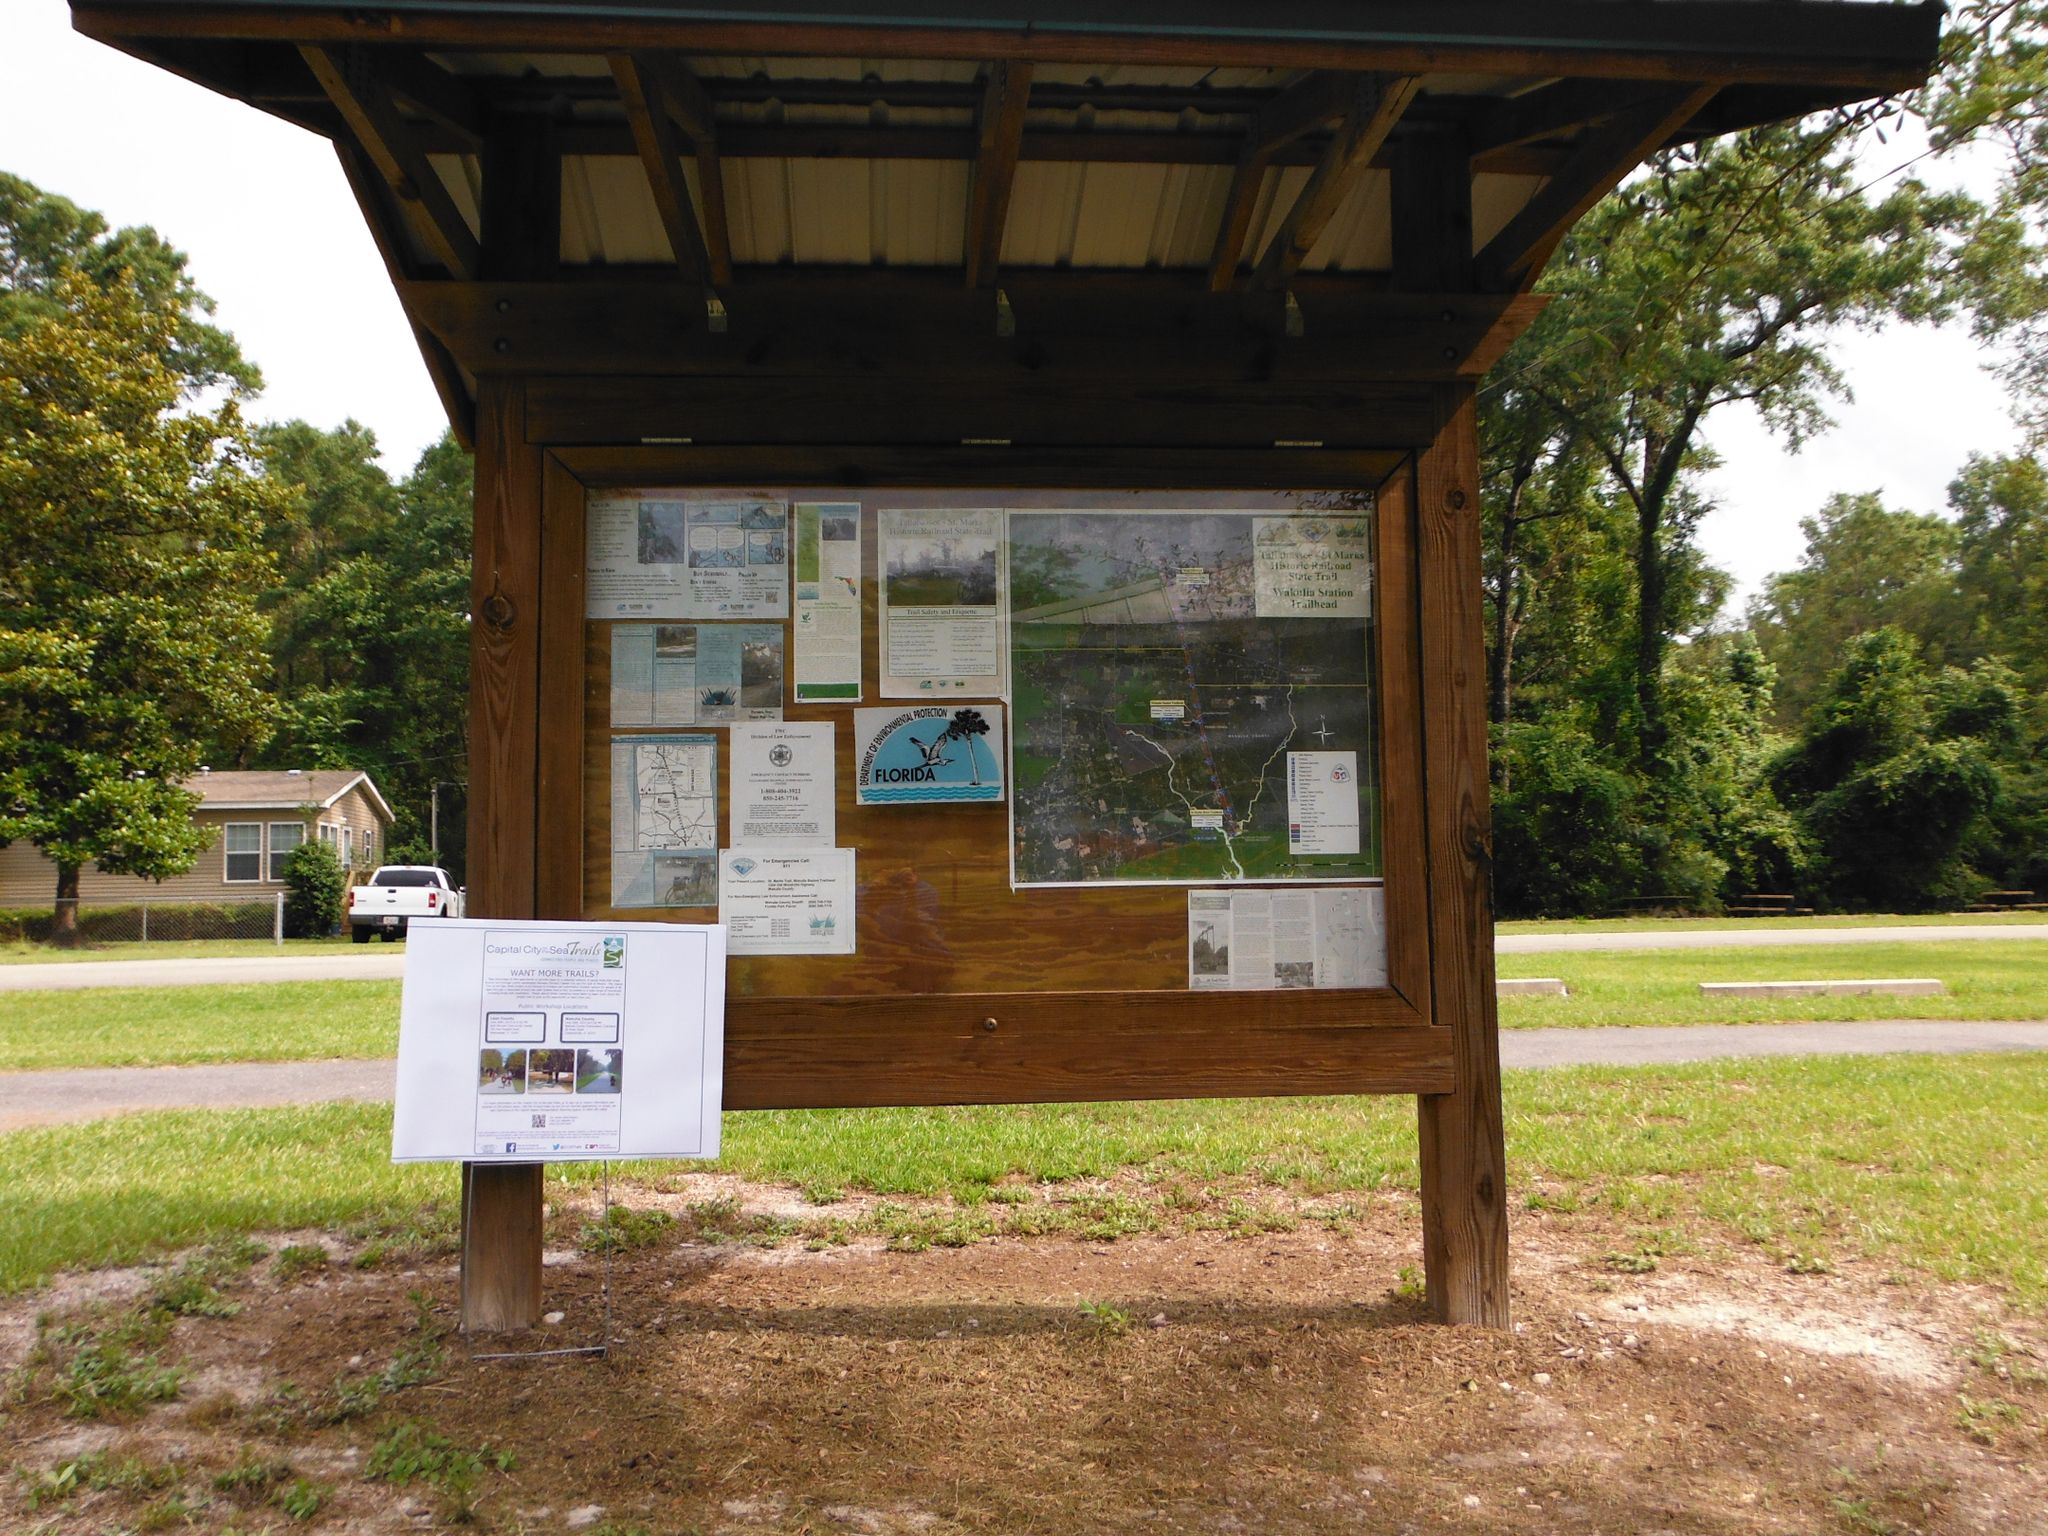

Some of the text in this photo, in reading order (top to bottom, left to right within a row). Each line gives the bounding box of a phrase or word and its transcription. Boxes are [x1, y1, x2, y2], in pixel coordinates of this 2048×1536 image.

[1289, 572, 1338, 581] State Trail
[1318, 588, 1353, 597] Station
[1291, 599, 1338, 609] Trailhead
[860, 751, 875, 786] DEPARTMENT
[875, 713, 914, 746] ENVIRONMENTAL
[913, 708, 948, 720] PROTECTION
[875, 768, 936, 783] FLORIDA
[486, 944, 521, 956] Capital
[523, 944, 540, 957] City
[549, 945, 568, 955] Sea
[566, 941, 601, 956] Trails
[510, 969, 600, 978] WANT MORE TRAILS?
